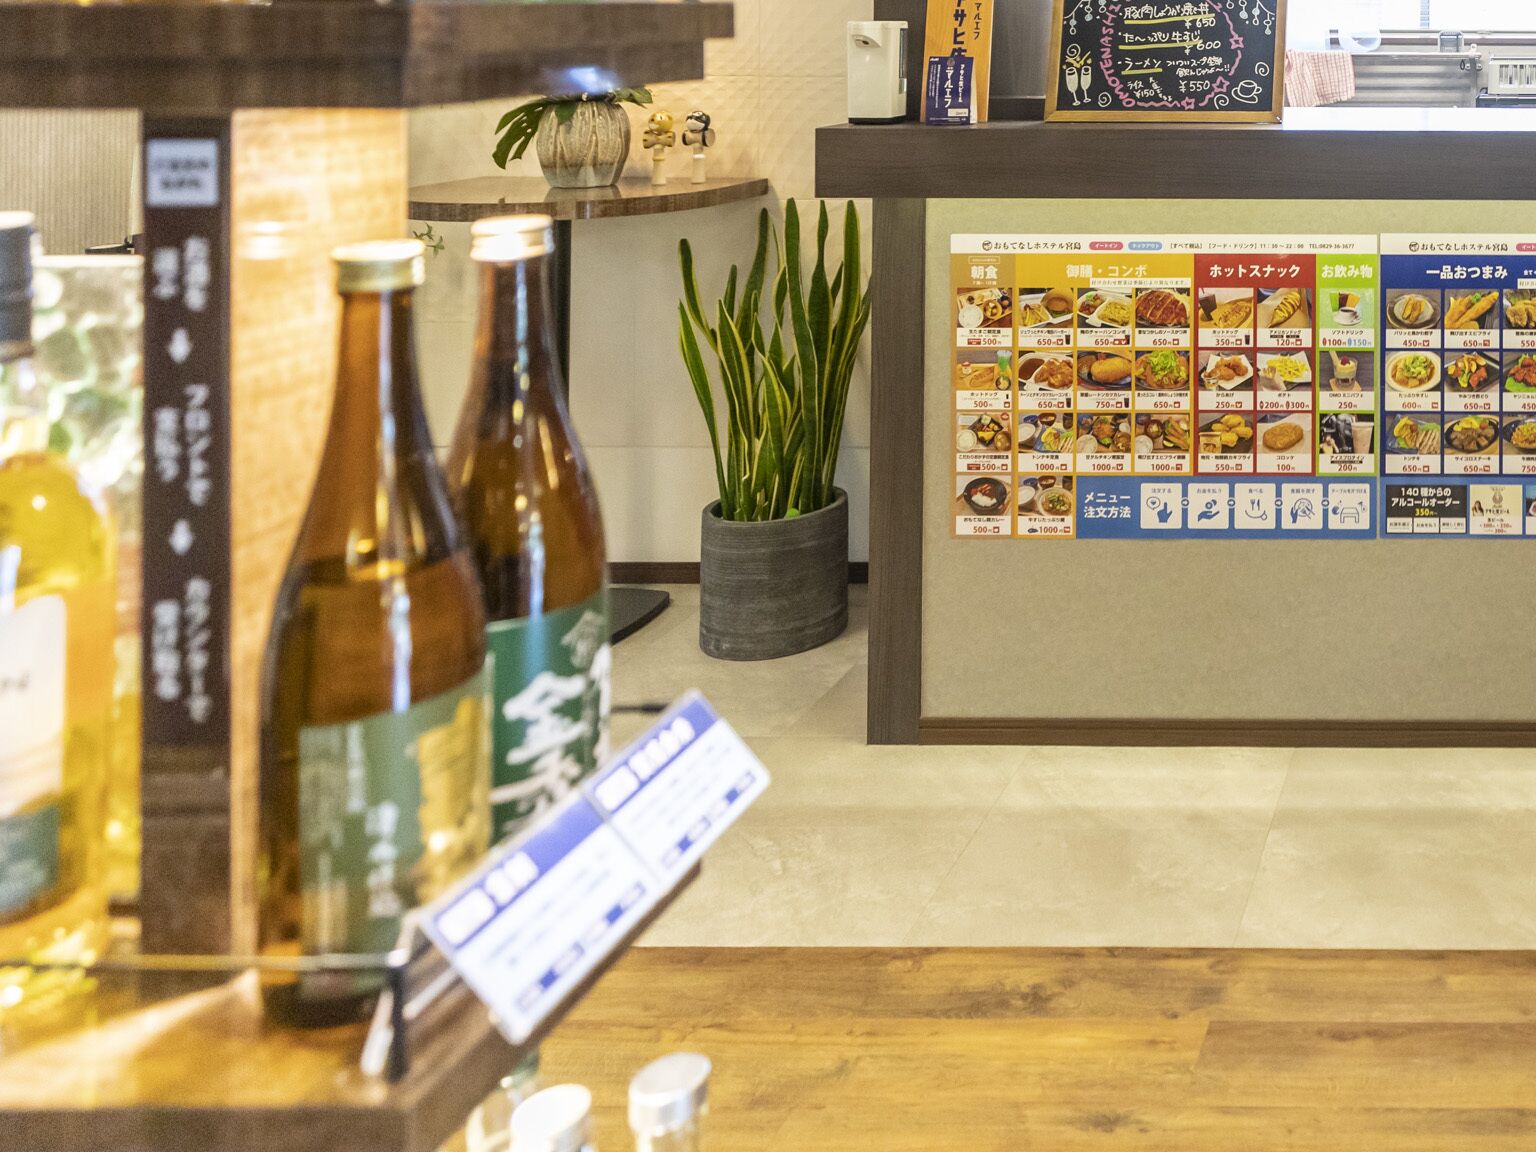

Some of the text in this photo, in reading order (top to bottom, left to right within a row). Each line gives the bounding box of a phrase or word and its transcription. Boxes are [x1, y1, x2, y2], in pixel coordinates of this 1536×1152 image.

[973, 2, 982, 40] マルエフ
[1124, 57, 1162, 70] ラーメン
[943, 67, 954, 108] マルエフ
[1127, 80, 1144, 89] ライス
[994, 241, 1082, 250] おもてなしホステル宮島
[1420, 243, 1508, 252] おもてなしホステル宮島
[970, 264, 998, 280] 朝食
[1066, 264, 1148, 278] 御膳・コンボ
[1209, 264, 1301, 278] ホットスナック
[1321, 264, 1373, 278] お飲み物
[1426, 265, 1508, 279] 一品おつまみ
[1084, 491, 1131, 503] メニュー
[1391, 497, 1460, 507] アルコールオーダー
[1083, 505, 1131, 519] 注文方法
